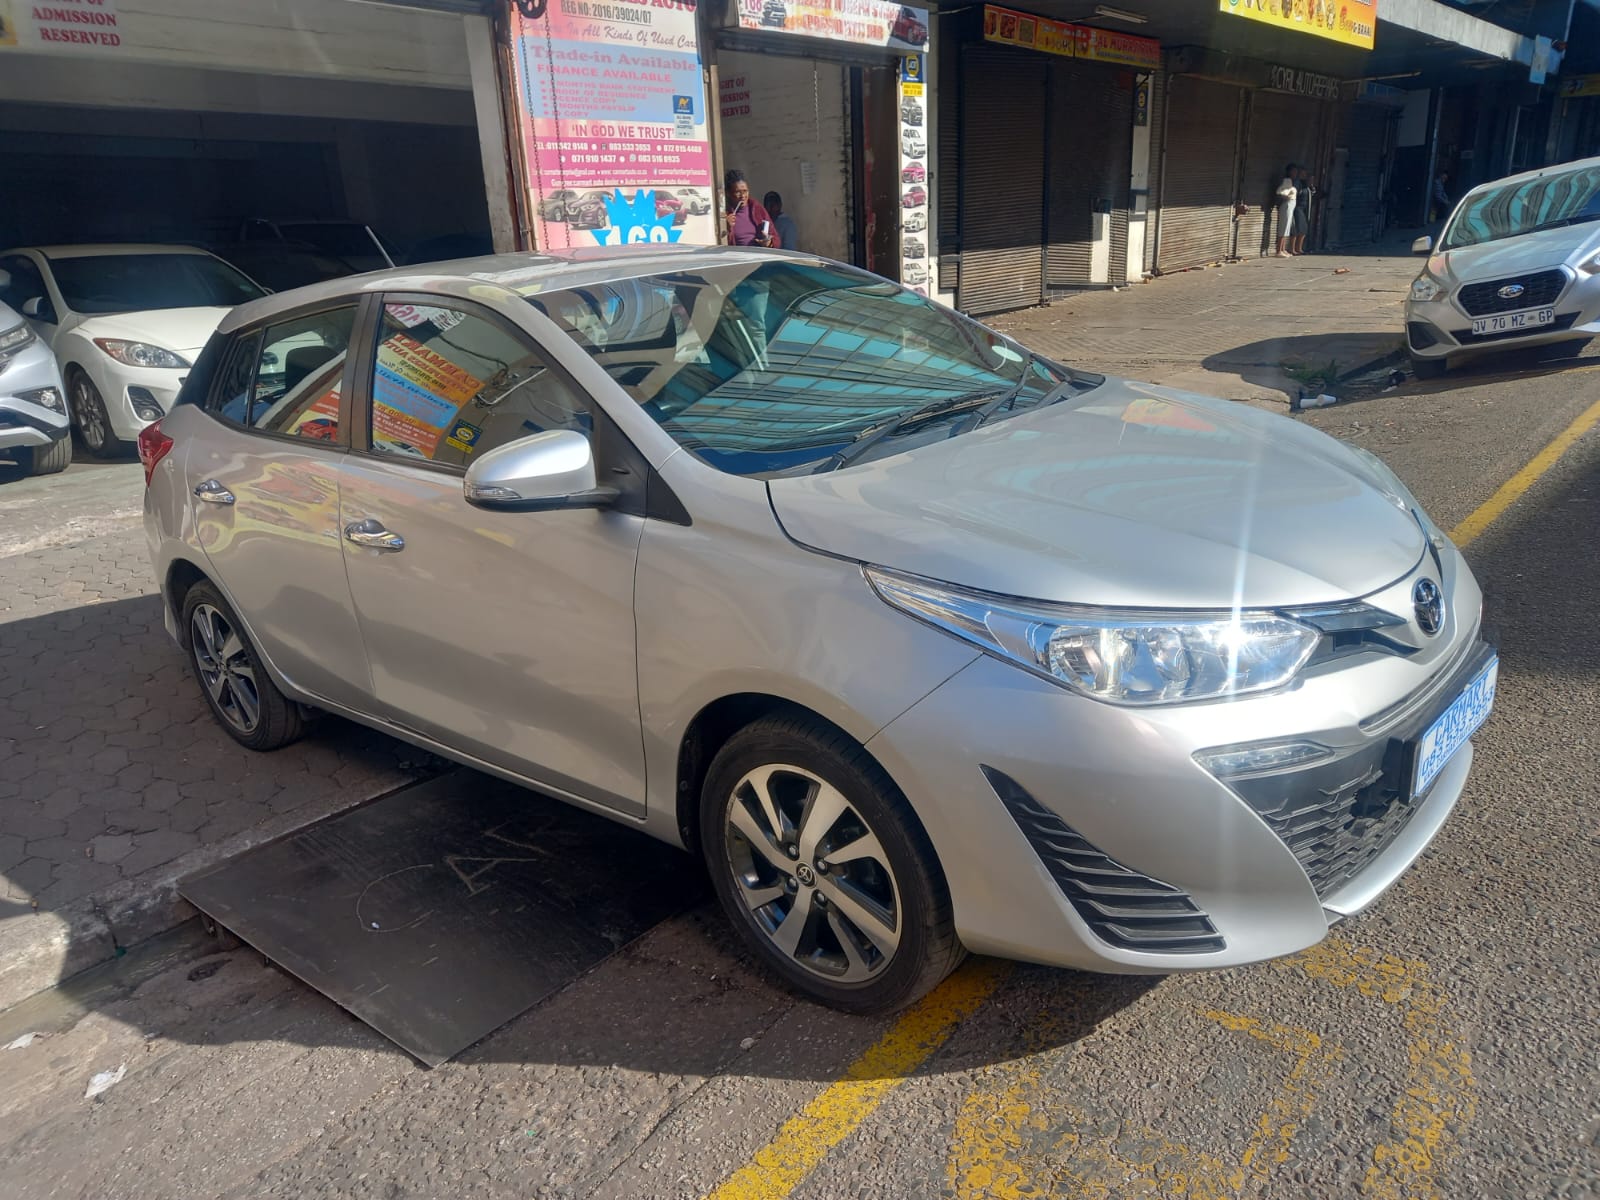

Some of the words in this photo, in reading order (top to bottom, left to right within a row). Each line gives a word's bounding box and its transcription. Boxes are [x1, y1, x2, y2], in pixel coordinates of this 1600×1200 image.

[561, 1, 576, 11] REG
[32, 7, 117, 27] ADMISSION
[40, 27, 121, 47] RESERVED
[582, 25, 600, 37] All
[604, 26, 633, 41] Kinds
[637, 32, 648, 46] Of
[650, 32, 674, 45] Used
[531, 45, 612, 64] Trade-in
[618, 53, 697, 72] Available
[537, 64, 599, 77] FINANCE
[603, 67, 672, 82] AVAILABLE
[592, 125, 615, 138] GOD
[618, 126, 635, 138] WE
[1473, 320, 1486, 333] JV
[1492, 317, 1506, 330] 70
[1511, 314, 1525, 327] MZ
[1538, 310, 1553, 323] GP
[1434, 672, 1489, 747] CARMART
[1422, 746, 1443, 774] 083
